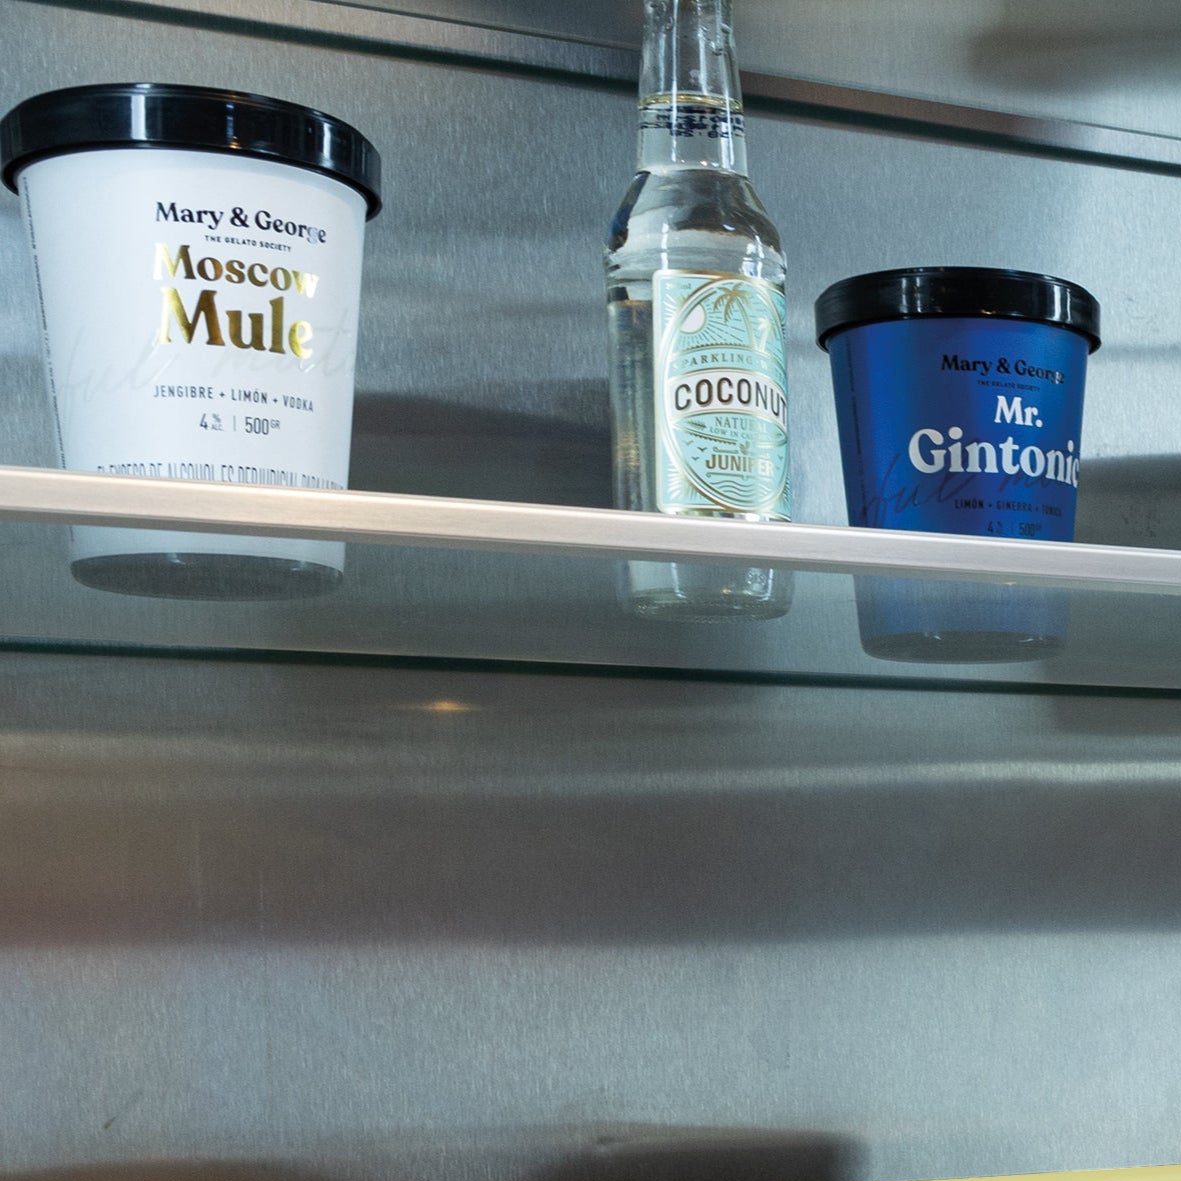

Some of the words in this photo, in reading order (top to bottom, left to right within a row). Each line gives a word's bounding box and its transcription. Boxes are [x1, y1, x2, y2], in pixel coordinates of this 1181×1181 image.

[155, 202, 224, 230] Mary
[229, 206, 250, 228] &
[254, 210, 327, 244] George
[205, 235, 222, 243] THE
[225, 236, 257, 247] GELATO
[259, 240, 292, 252] SOCIETY
[152, 243, 319, 298] Moscow
[158, 286, 313, 360] Mule
[941, 354, 993, 376] Mary
[996, 357, 1011, 374] &
[153, 385, 214, 400] JENGIBRE
[231, 388, 268, 404] LIMÓN
[282, 395, 314, 412] VODKA
[675, 377, 787, 424] COCONUT
[994, 395, 1043, 427] Mr.
